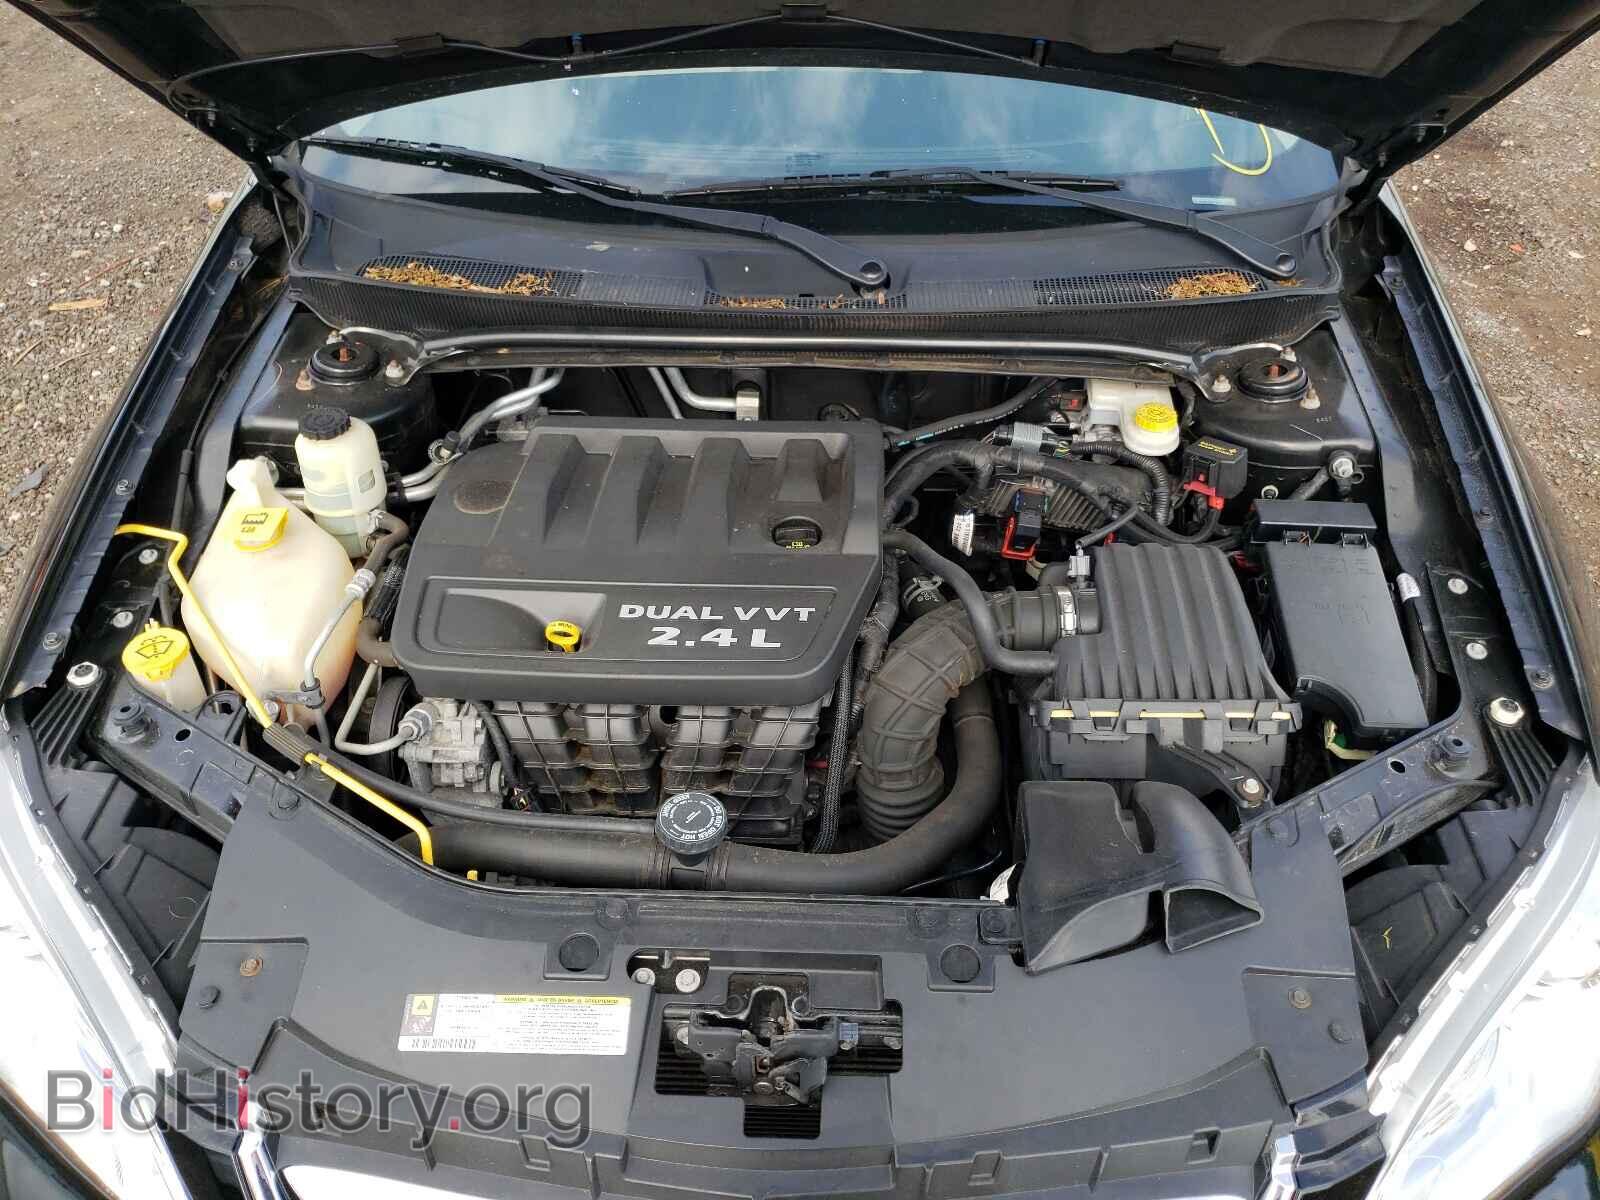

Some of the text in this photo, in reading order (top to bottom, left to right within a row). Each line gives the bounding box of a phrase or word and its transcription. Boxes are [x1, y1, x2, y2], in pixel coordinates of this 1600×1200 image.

[619, 605, 816, 622] DUAL VVT
[714, 816, 722, 827] NOT
[697, 826, 716, 840] OPEN
